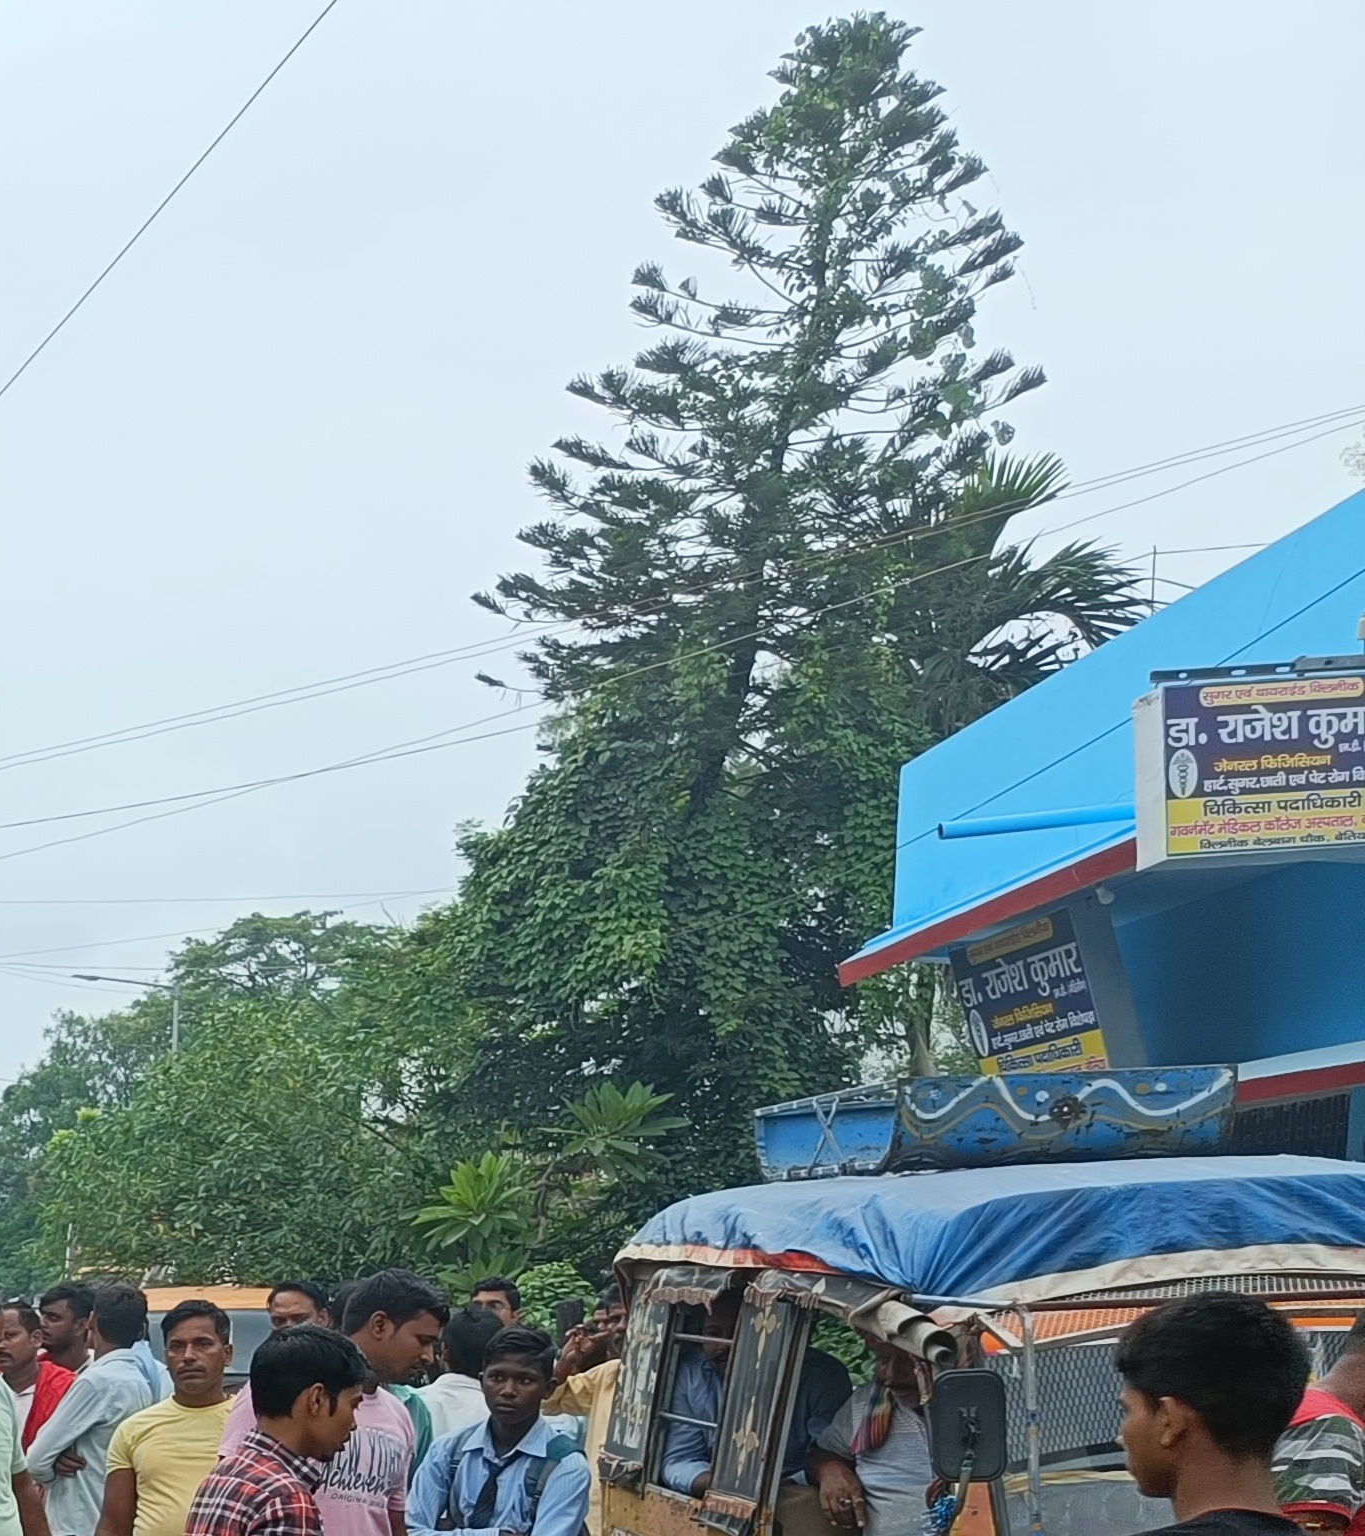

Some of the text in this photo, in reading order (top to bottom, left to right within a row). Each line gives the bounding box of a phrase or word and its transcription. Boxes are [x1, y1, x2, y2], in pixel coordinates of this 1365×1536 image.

[1202, 690, 1231, 705] सुगर
[1167, 717, 1208, 748] डा.
[1217, 705, 1302, 743] राजेश
[1213, 753, 1331, 772] जेनरल फिजिसियन
[1203, 790, 1362, 816] चिकित्सा पदाधिकारी
[1218, 818, 1262, 834] मेडिकल
[1264, 816, 1302, 831] कॉलेज
[959, 977, 982, 1008] डा.
[981, 958, 1029, 999] राजेश
[1027, 941, 1082, 996] कुमार
